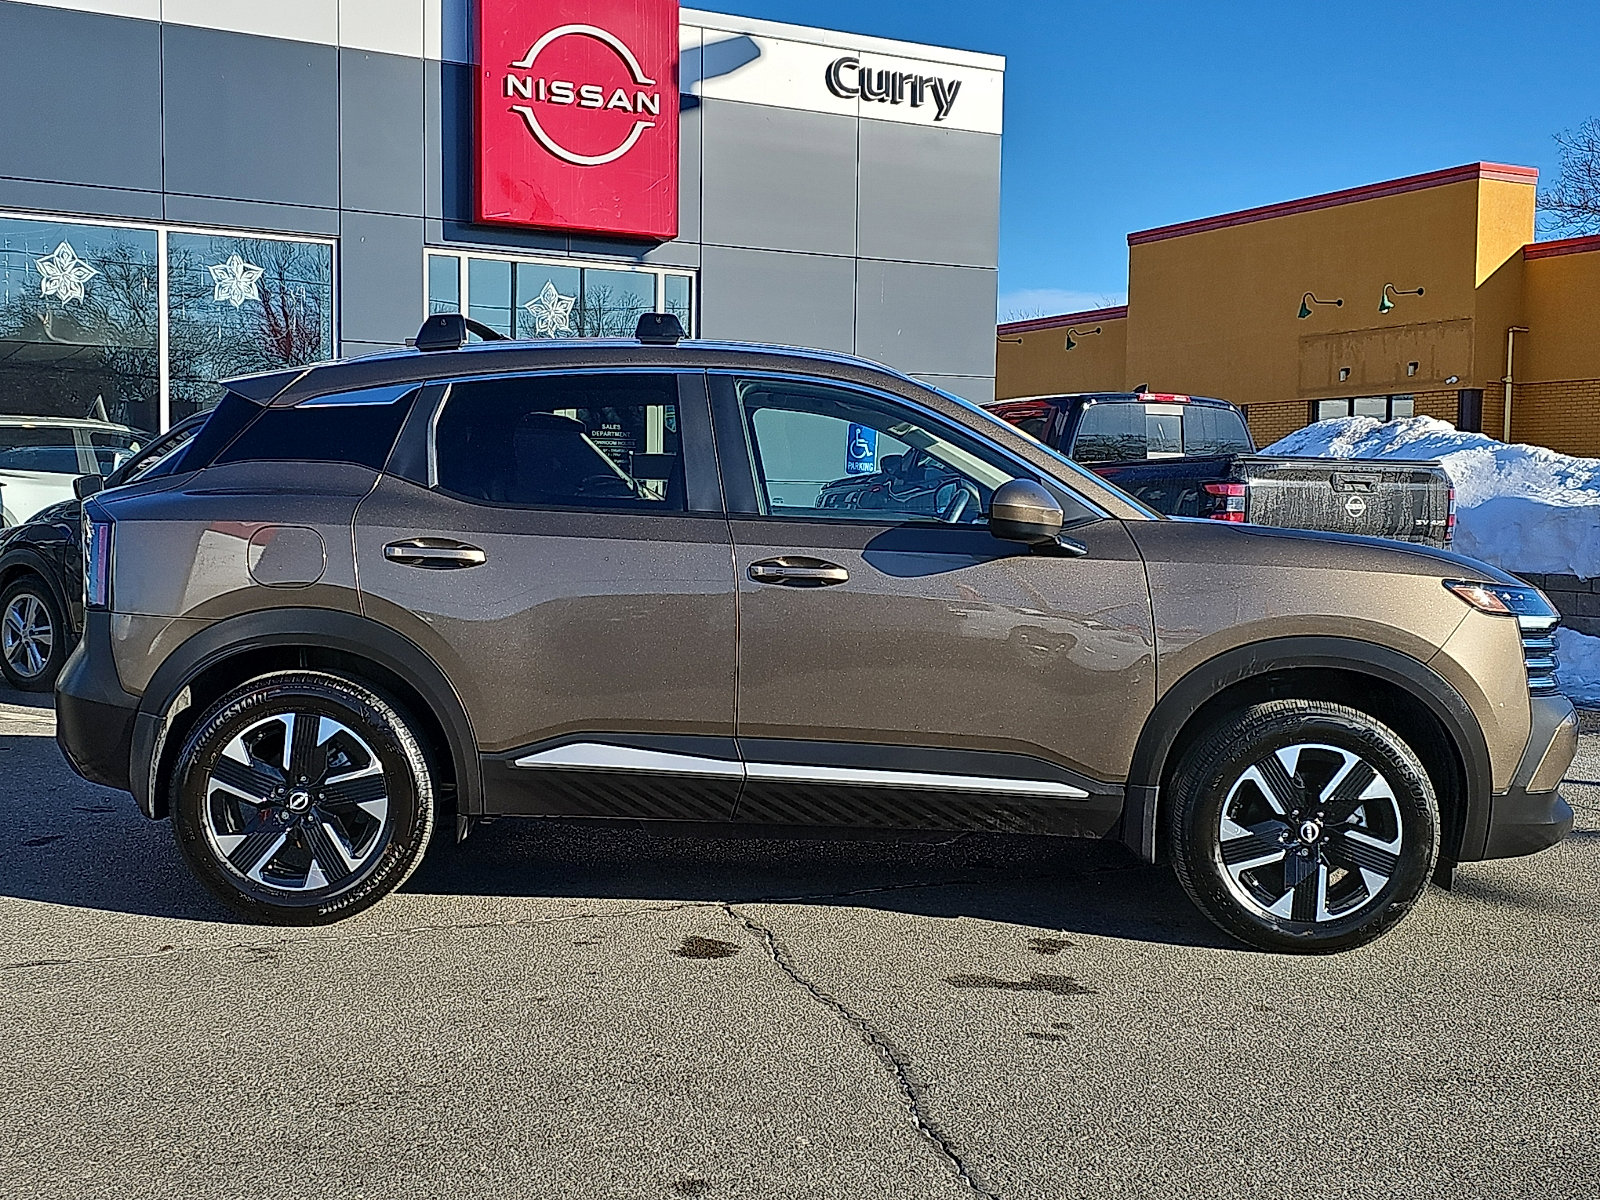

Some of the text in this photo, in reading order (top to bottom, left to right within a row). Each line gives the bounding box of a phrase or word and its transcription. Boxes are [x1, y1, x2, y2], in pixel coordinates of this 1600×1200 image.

[503, 74, 660, 115] NISSAN
[826, 56, 962, 120] Curry
[847, 461, 874, 471] PARKING
